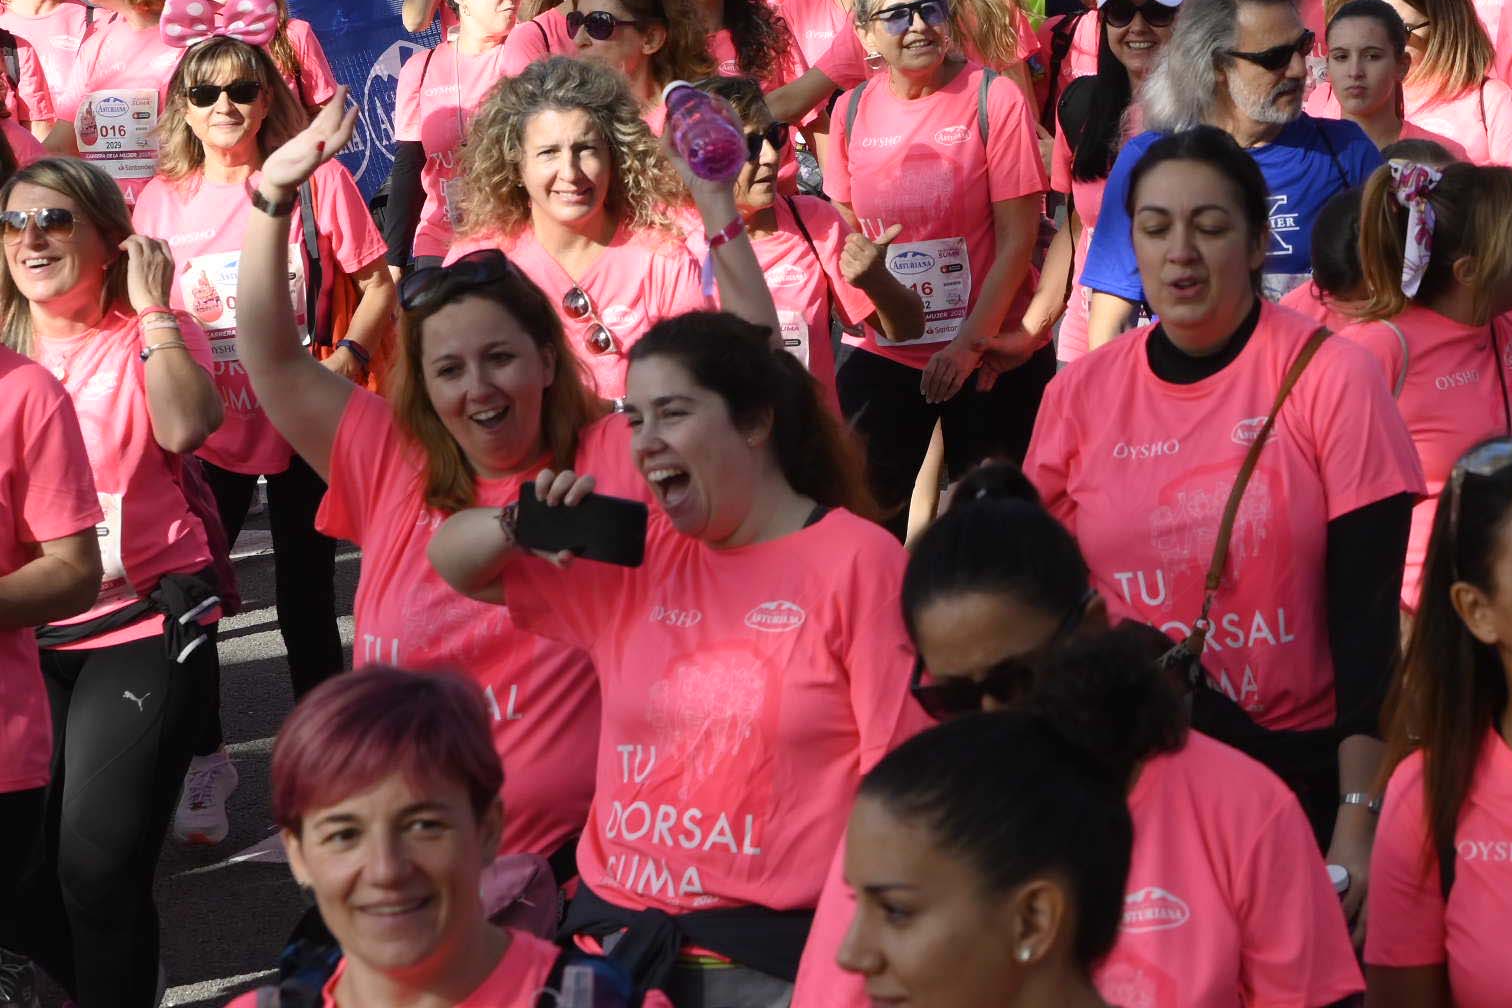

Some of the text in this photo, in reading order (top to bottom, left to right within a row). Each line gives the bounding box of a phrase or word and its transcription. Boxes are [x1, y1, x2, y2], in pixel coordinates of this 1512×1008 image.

[99, 125, 127, 138] 016
[1270, 217, 1295, 228] IER
[893, 259, 933, 269] ASTURIANA
[910, 281, 934, 297] 16
[1435, 368, 1480, 391] OYSHO
[1113, 440, 1180, 458] OYSHO
[1113, 569, 1167, 606] TU
[1160, 607, 1295, 653] ORSAL
[617, 744, 657, 785] TU
[605, 800, 761, 856] DORSAL
